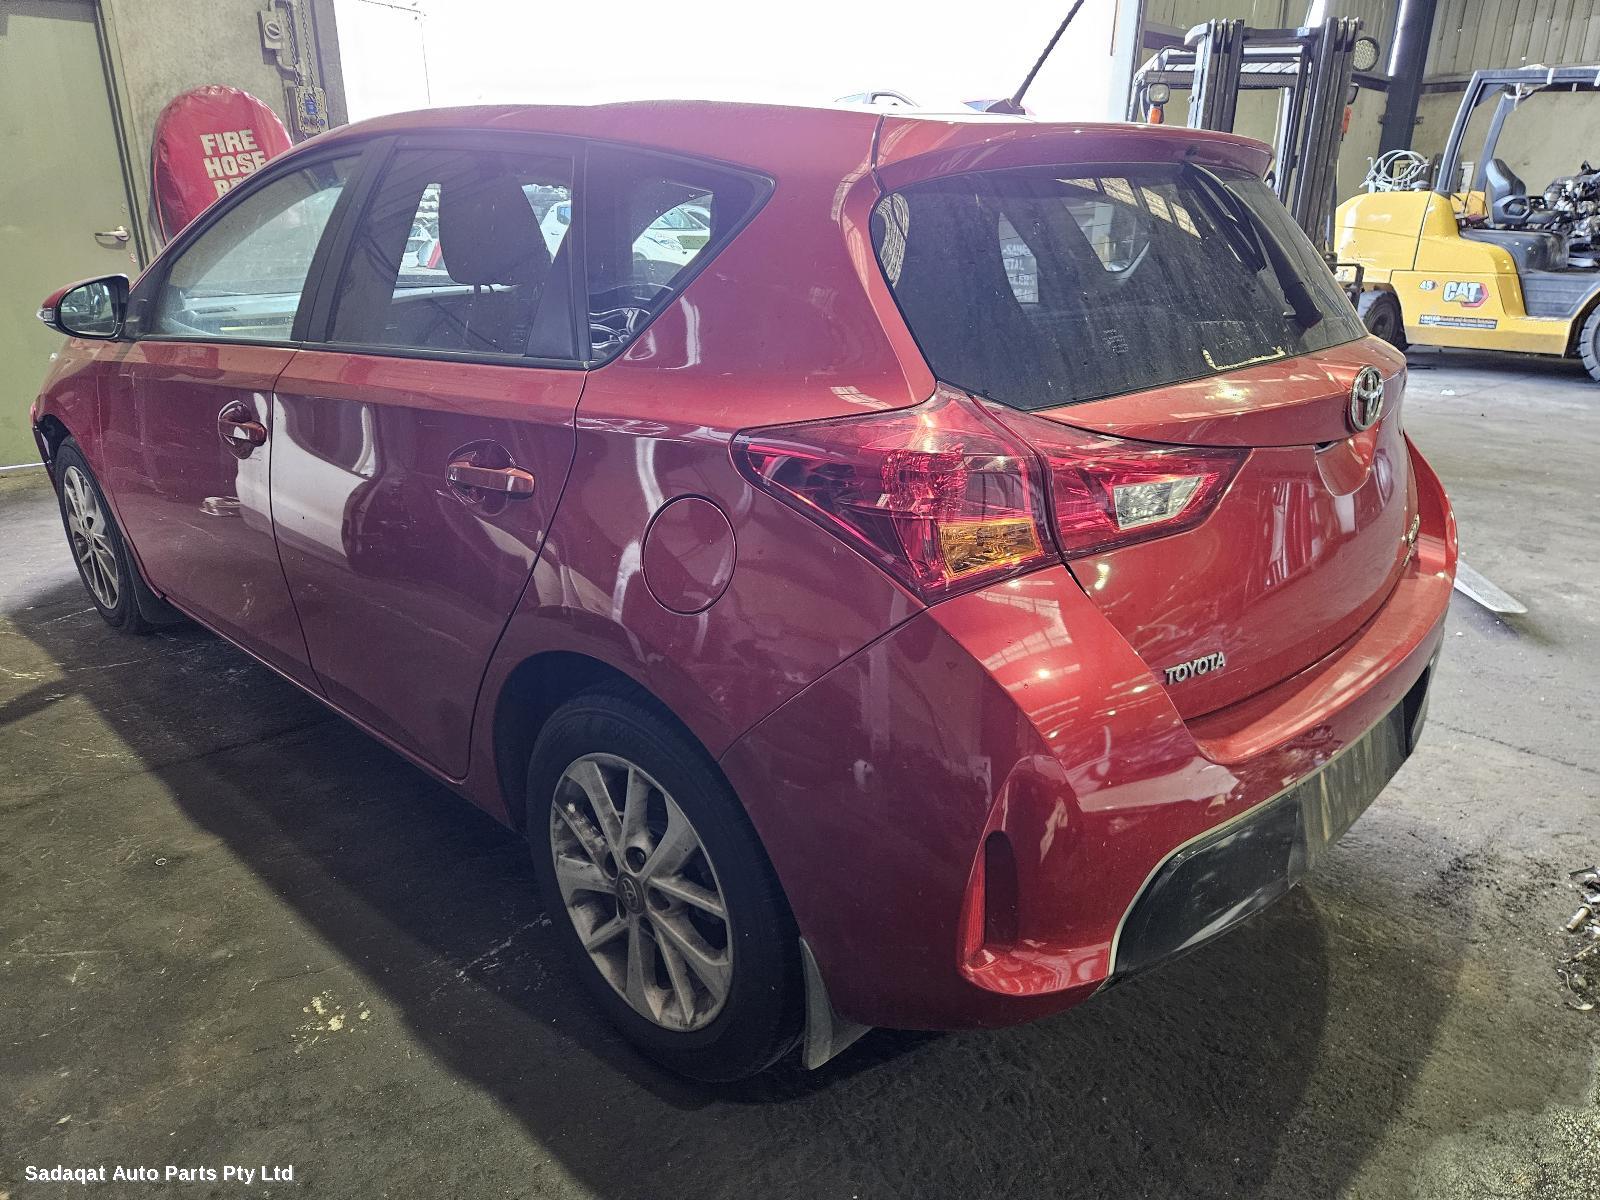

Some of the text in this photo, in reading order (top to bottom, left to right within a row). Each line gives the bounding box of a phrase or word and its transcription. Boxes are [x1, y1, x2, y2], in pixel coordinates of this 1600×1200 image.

[200, 129, 258, 155] FIRE
[203, 151, 266, 178] HOSE
[1003, 258, 1025, 271] ETAL
[1443, 281, 1480, 302] CAT
[1163, 651, 1226, 685] TOYOTA
